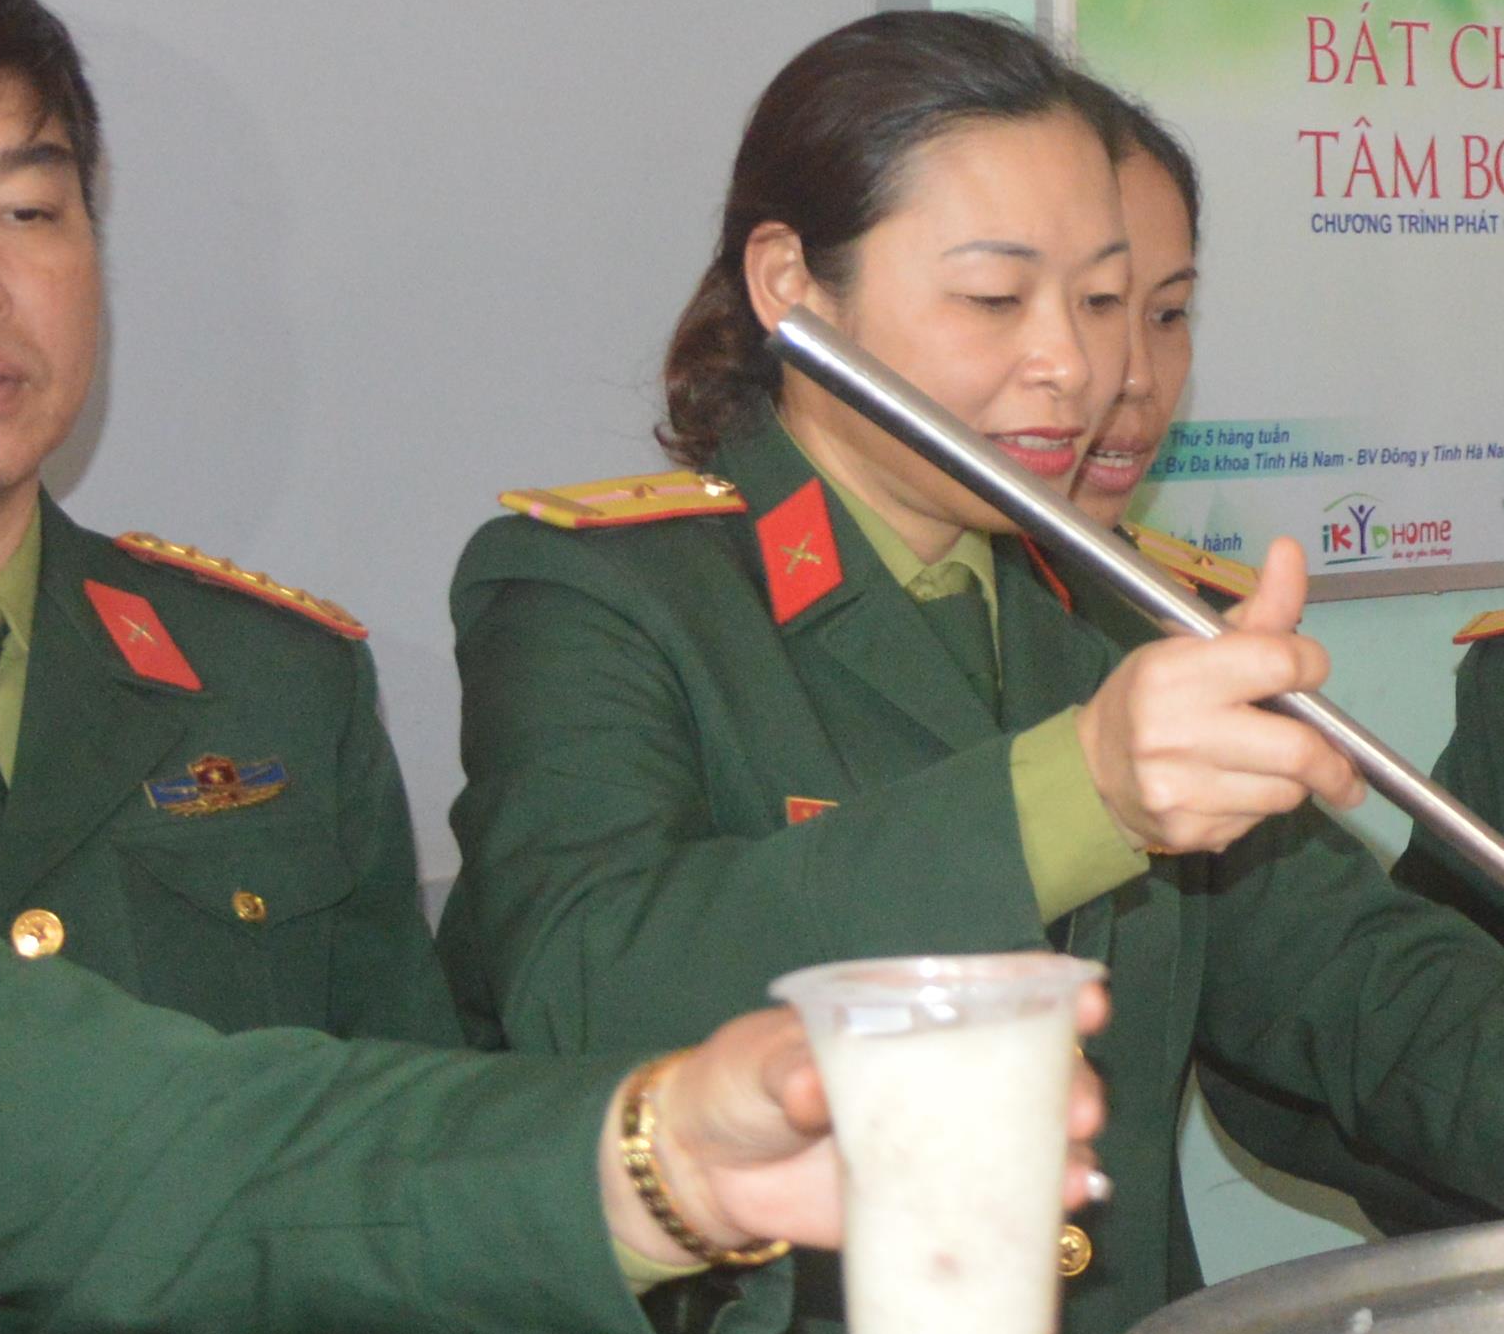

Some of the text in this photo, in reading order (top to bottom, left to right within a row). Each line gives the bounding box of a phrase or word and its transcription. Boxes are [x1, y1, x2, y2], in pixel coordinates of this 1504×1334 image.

[1307, 1, 1431, 87] BÁT
[1298, 115, 1441, 199] TÂM
[1310, 212, 1392, 235] CHƯƠNG
[1397, 209, 1450, 235] TRÌNH
[1454, 209, 1498, 235] PHÁT
[1206, 429, 1214, 447] 5
[1217, 428, 1255, 450] hàng
[1214, 453, 1250, 472] khoa
[1312, 451, 1345, 469] Nam
[1356, 448, 1378, 467] BV
[1420, 449, 1430, 467] y
